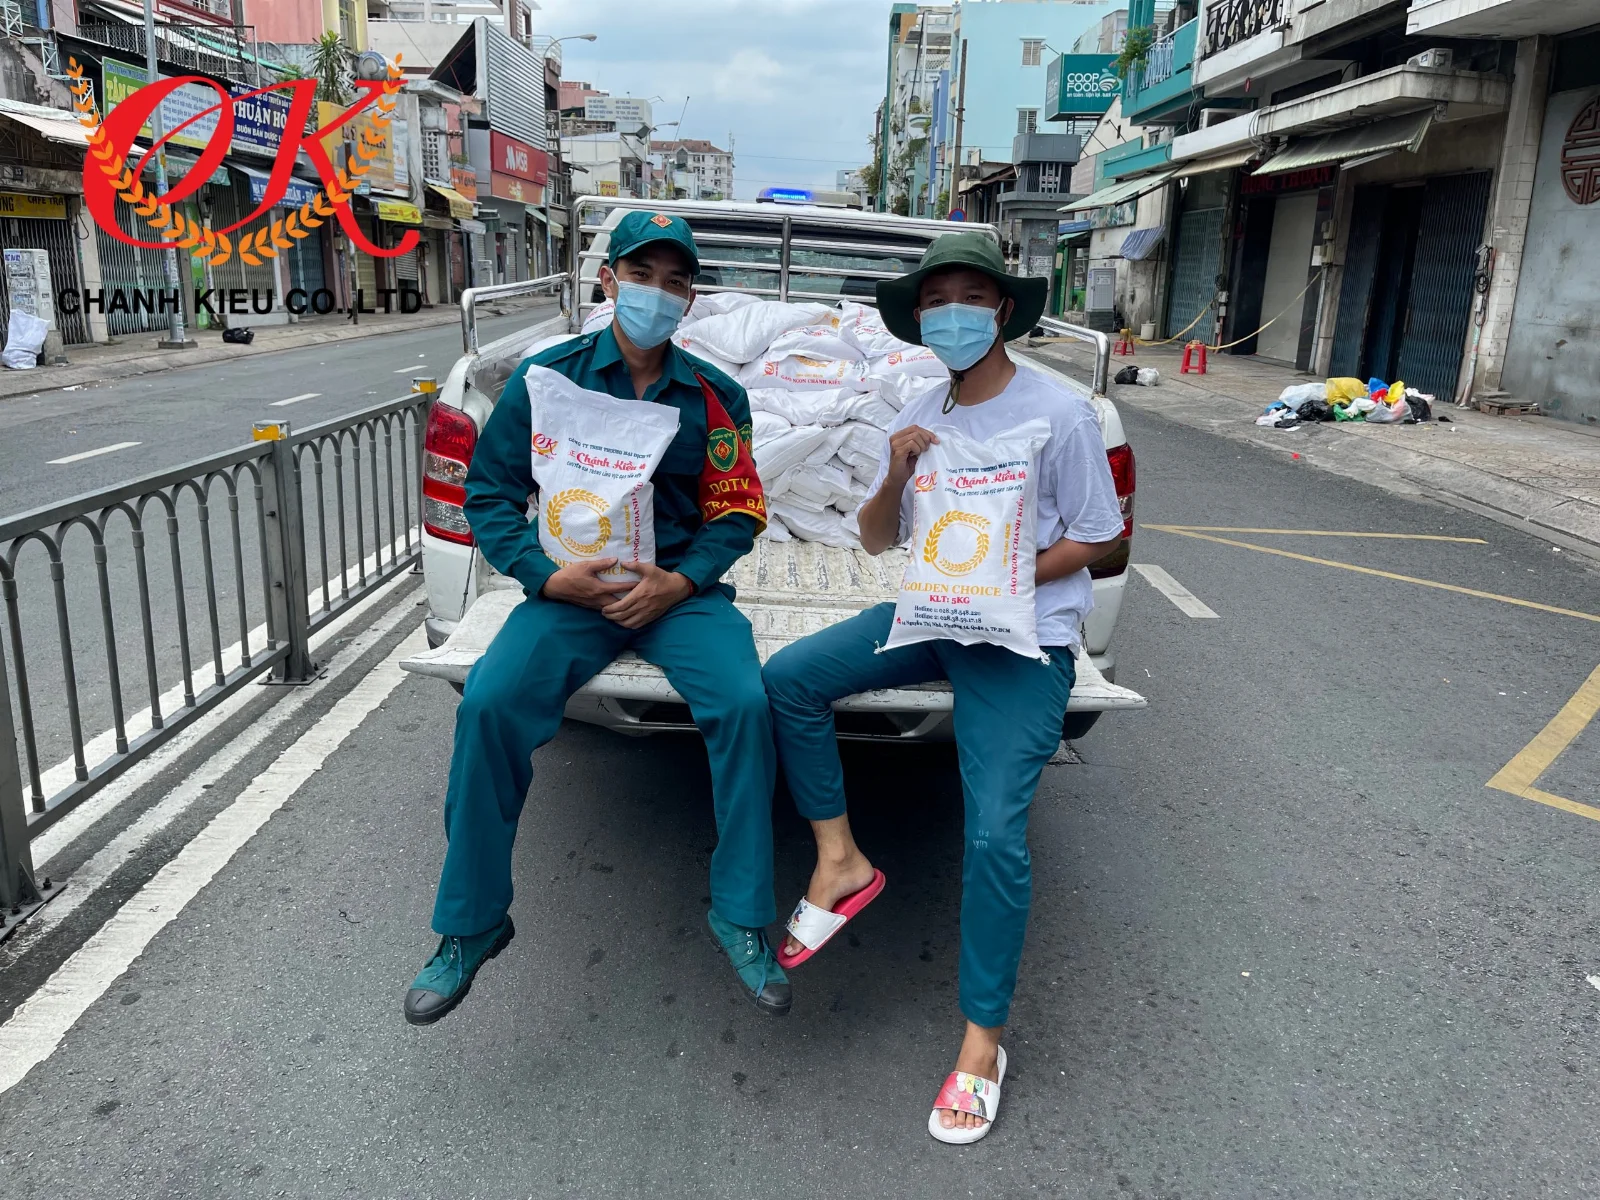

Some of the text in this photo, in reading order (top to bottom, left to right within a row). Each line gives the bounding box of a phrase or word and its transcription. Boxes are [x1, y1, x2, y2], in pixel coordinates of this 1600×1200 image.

[233, 100, 271, 126] THUẬN
[273, 108, 287, 129] HÒ
[516, 151, 528, 173] MSB
[576, 452, 610, 468] Chánh
[709, 478, 749, 494] DQTV
[955, 475, 988, 489] Chánh
[904, 582, 1001, 597] GOLDEN CHOICE
[929, 594, 970, 605] KLT: 5KG
[914, 612, 933, 620] Hotline
